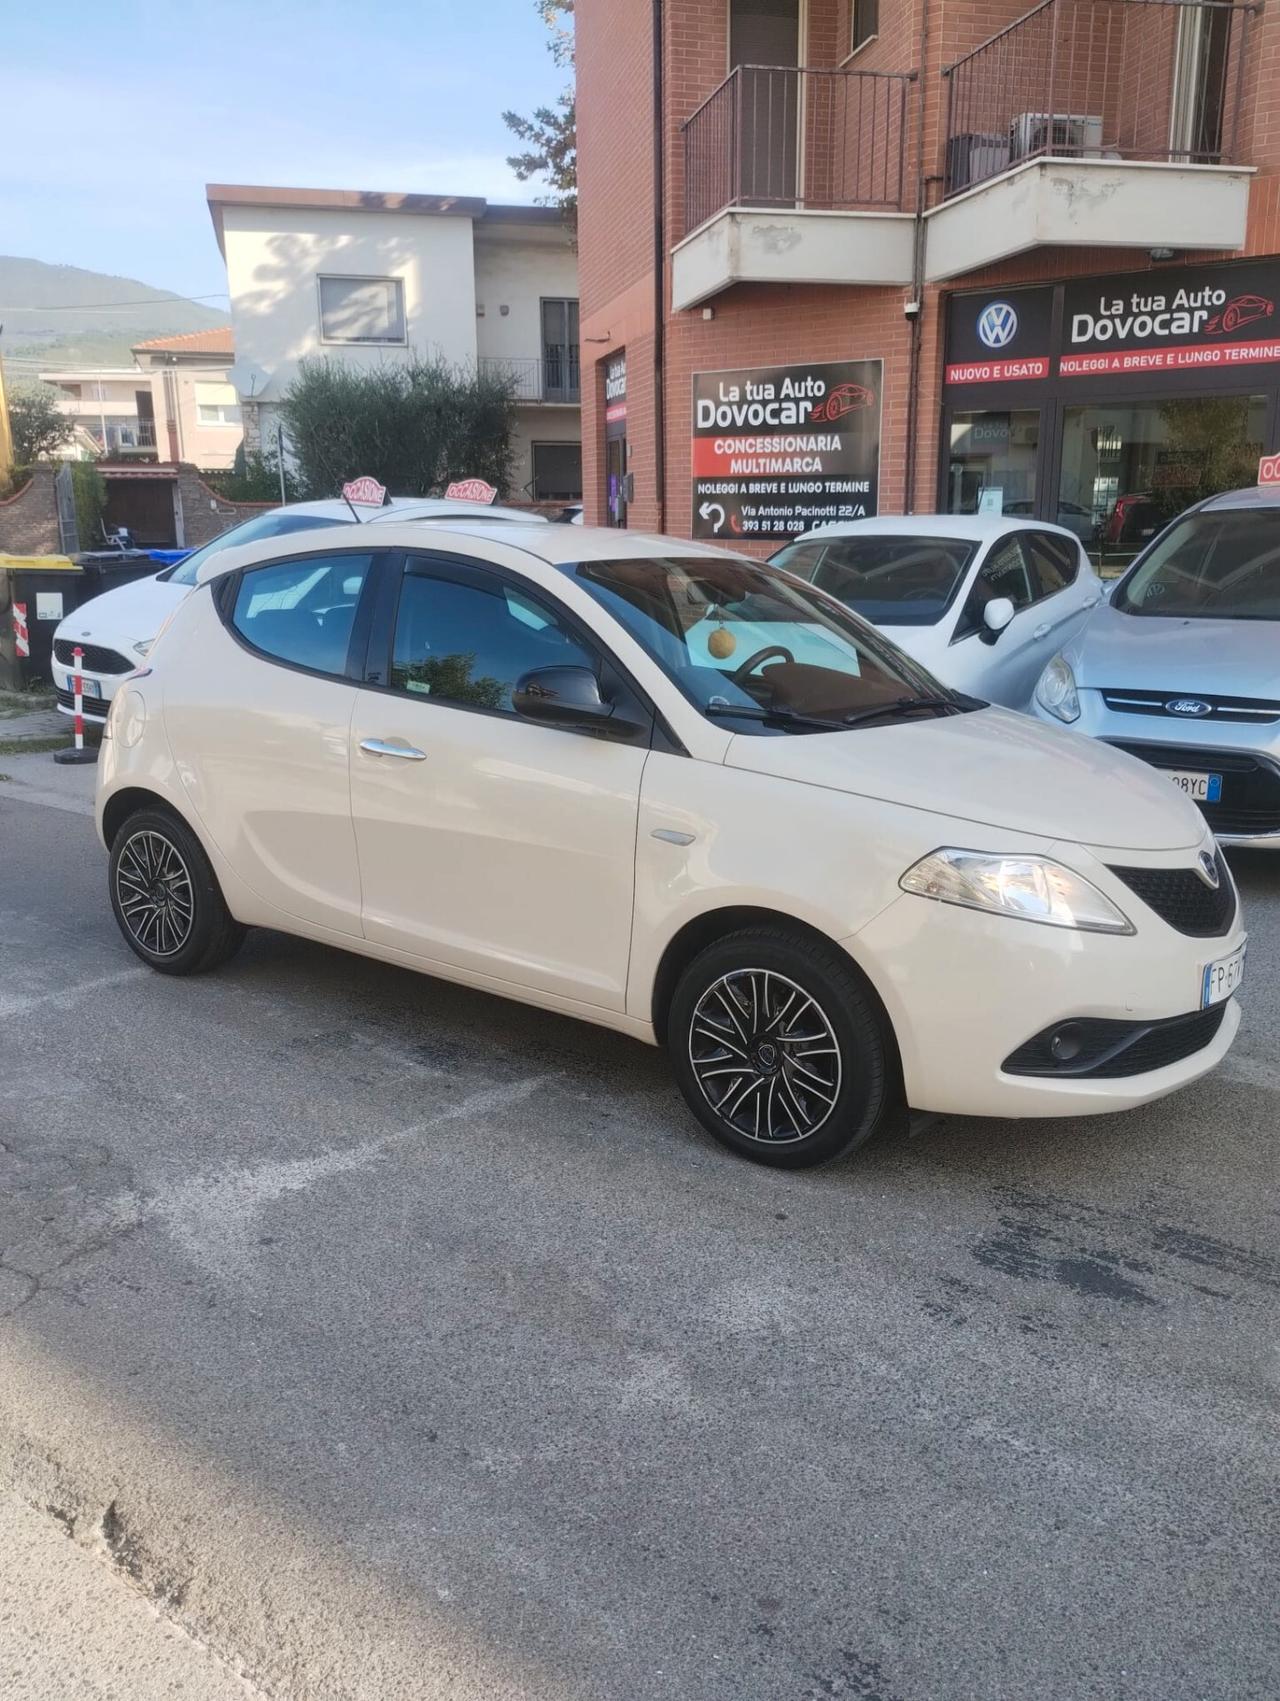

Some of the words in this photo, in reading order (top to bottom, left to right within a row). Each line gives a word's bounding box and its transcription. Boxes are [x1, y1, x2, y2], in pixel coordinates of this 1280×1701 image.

[1100, 296, 1124, 316] La
[1131, 293, 1166, 313] tua
[1172, 286, 1226, 309] Auto
[1071, 310, 1208, 343] Dovocar
[1059, 358, 1109, 372] NOLEGGI
[1112, 357, 1120, 369] A
[1123, 354, 1163, 368] BREVE
[1166, 353, 1175, 365] E
[1178, 350, 1221, 364] LUNGO
[1224, 345, 1280, 360] TERMINE
[950, 367, 990, 381] NUOVO
[993, 366, 1001, 377] E
[1004, 363, 1043, 376] USATO
[719, 382, 740, 402] La
[745, 380, 775, 401] tua
[780, 376, 826, 399] Auto
[697, 399, 813, 428] Dovocar
[714, 435, 842, 455] CONCESSIONARIA
[730, 457, 823, 474] MULTIMARCA
[449, 483, 495, 501] OCCASIONE
[697, 483, 738, 494] NOLEGGI
[740, 483, 747, 493] A
[749, 483, 778, 493] BREVE
[780, 483, 786, 493] E
[788, 482, 823, 493] LUNGO
[825, 481, 869, 493] TERMINE
[741, 505, 756, 516] Via
[758, 505, 793, 516] Antonio
[795, 505, 836, 516] Pacinotti
[838, 504, 866, 517] 22/A
[742, 521, 759, 531] 393
[761, 521, 771, 531] 51
[773, 521, 784, 531] 28
[787, 520, 805, 531] 028
[1174, 701, 1200, 713] Ford
